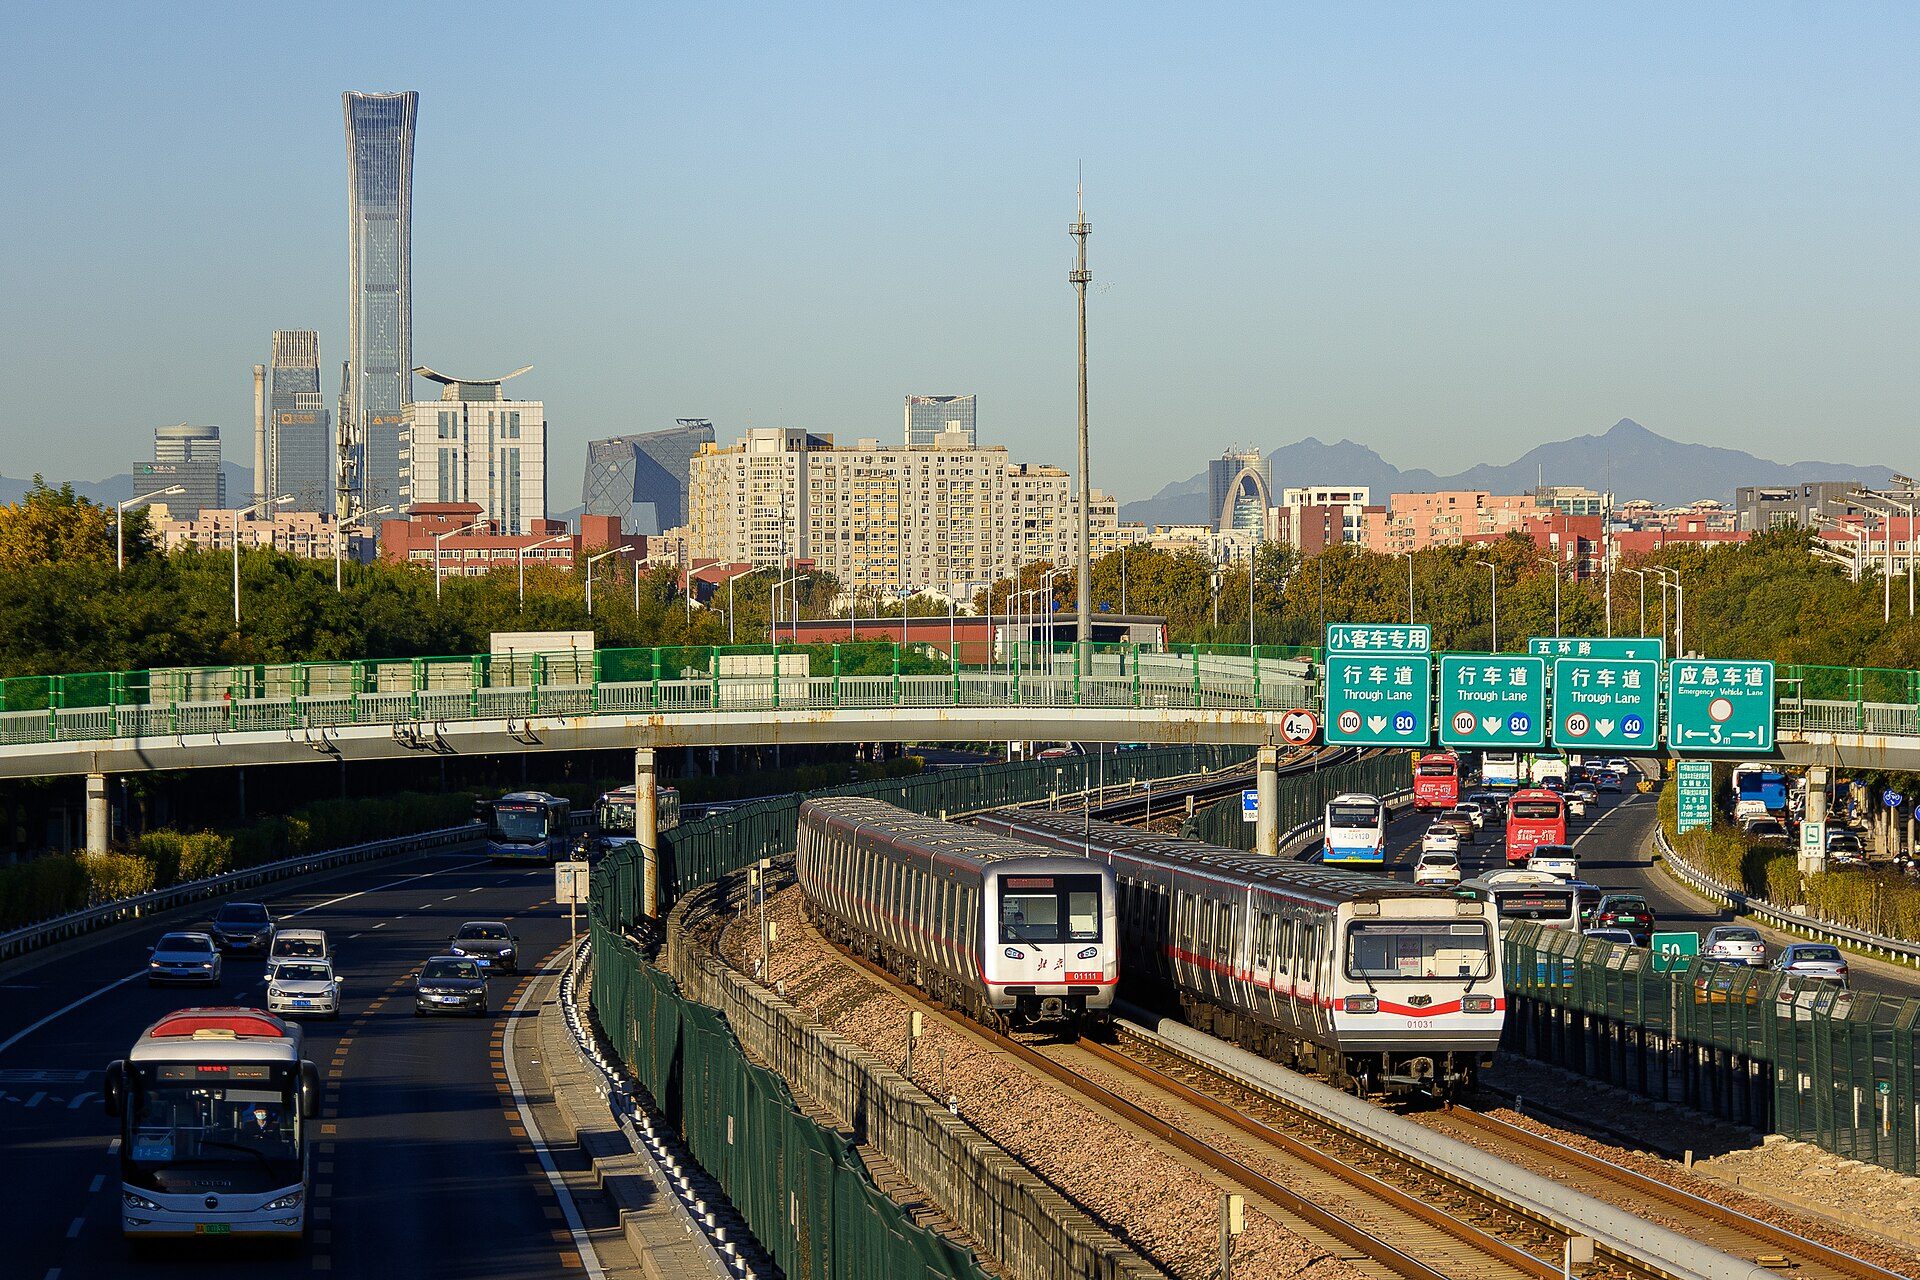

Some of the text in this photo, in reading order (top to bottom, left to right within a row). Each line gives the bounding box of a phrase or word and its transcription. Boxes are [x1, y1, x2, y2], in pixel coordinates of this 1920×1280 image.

[1331, 629, 1426, 649] 小客车专用
[1537, 641, 1592, 656] 五环路
[1343, 665, 1413, 685] 行车道
[1457, 665, 1528, 686] 行车道
[1571, 667, 1642, 689] 行车道
[1679, 665, 1764, 686] 应急车道
[1343, 688, 1413, 702] Through Lane
[1457, 689, 1528, 702] Through Lane
[1571, 691, 1641, 705] Through Lane
[1678, 687, 1764, 697] Emergency Vehicle Lane
[1285, 720, 1310, 734] 4.5m
[1341, 716, 1413, 730] 100 80
[1456, 717, 1528, 730] 100 80
[1570, 718, 1640, 732] 80 60
[1662, 943, 1681, 962] 50
[1073, 972, 1097, 980] 01111
[1407, 1020, 1433, 1029] 01031
[138, 1148, 168, 1158] 14-2
